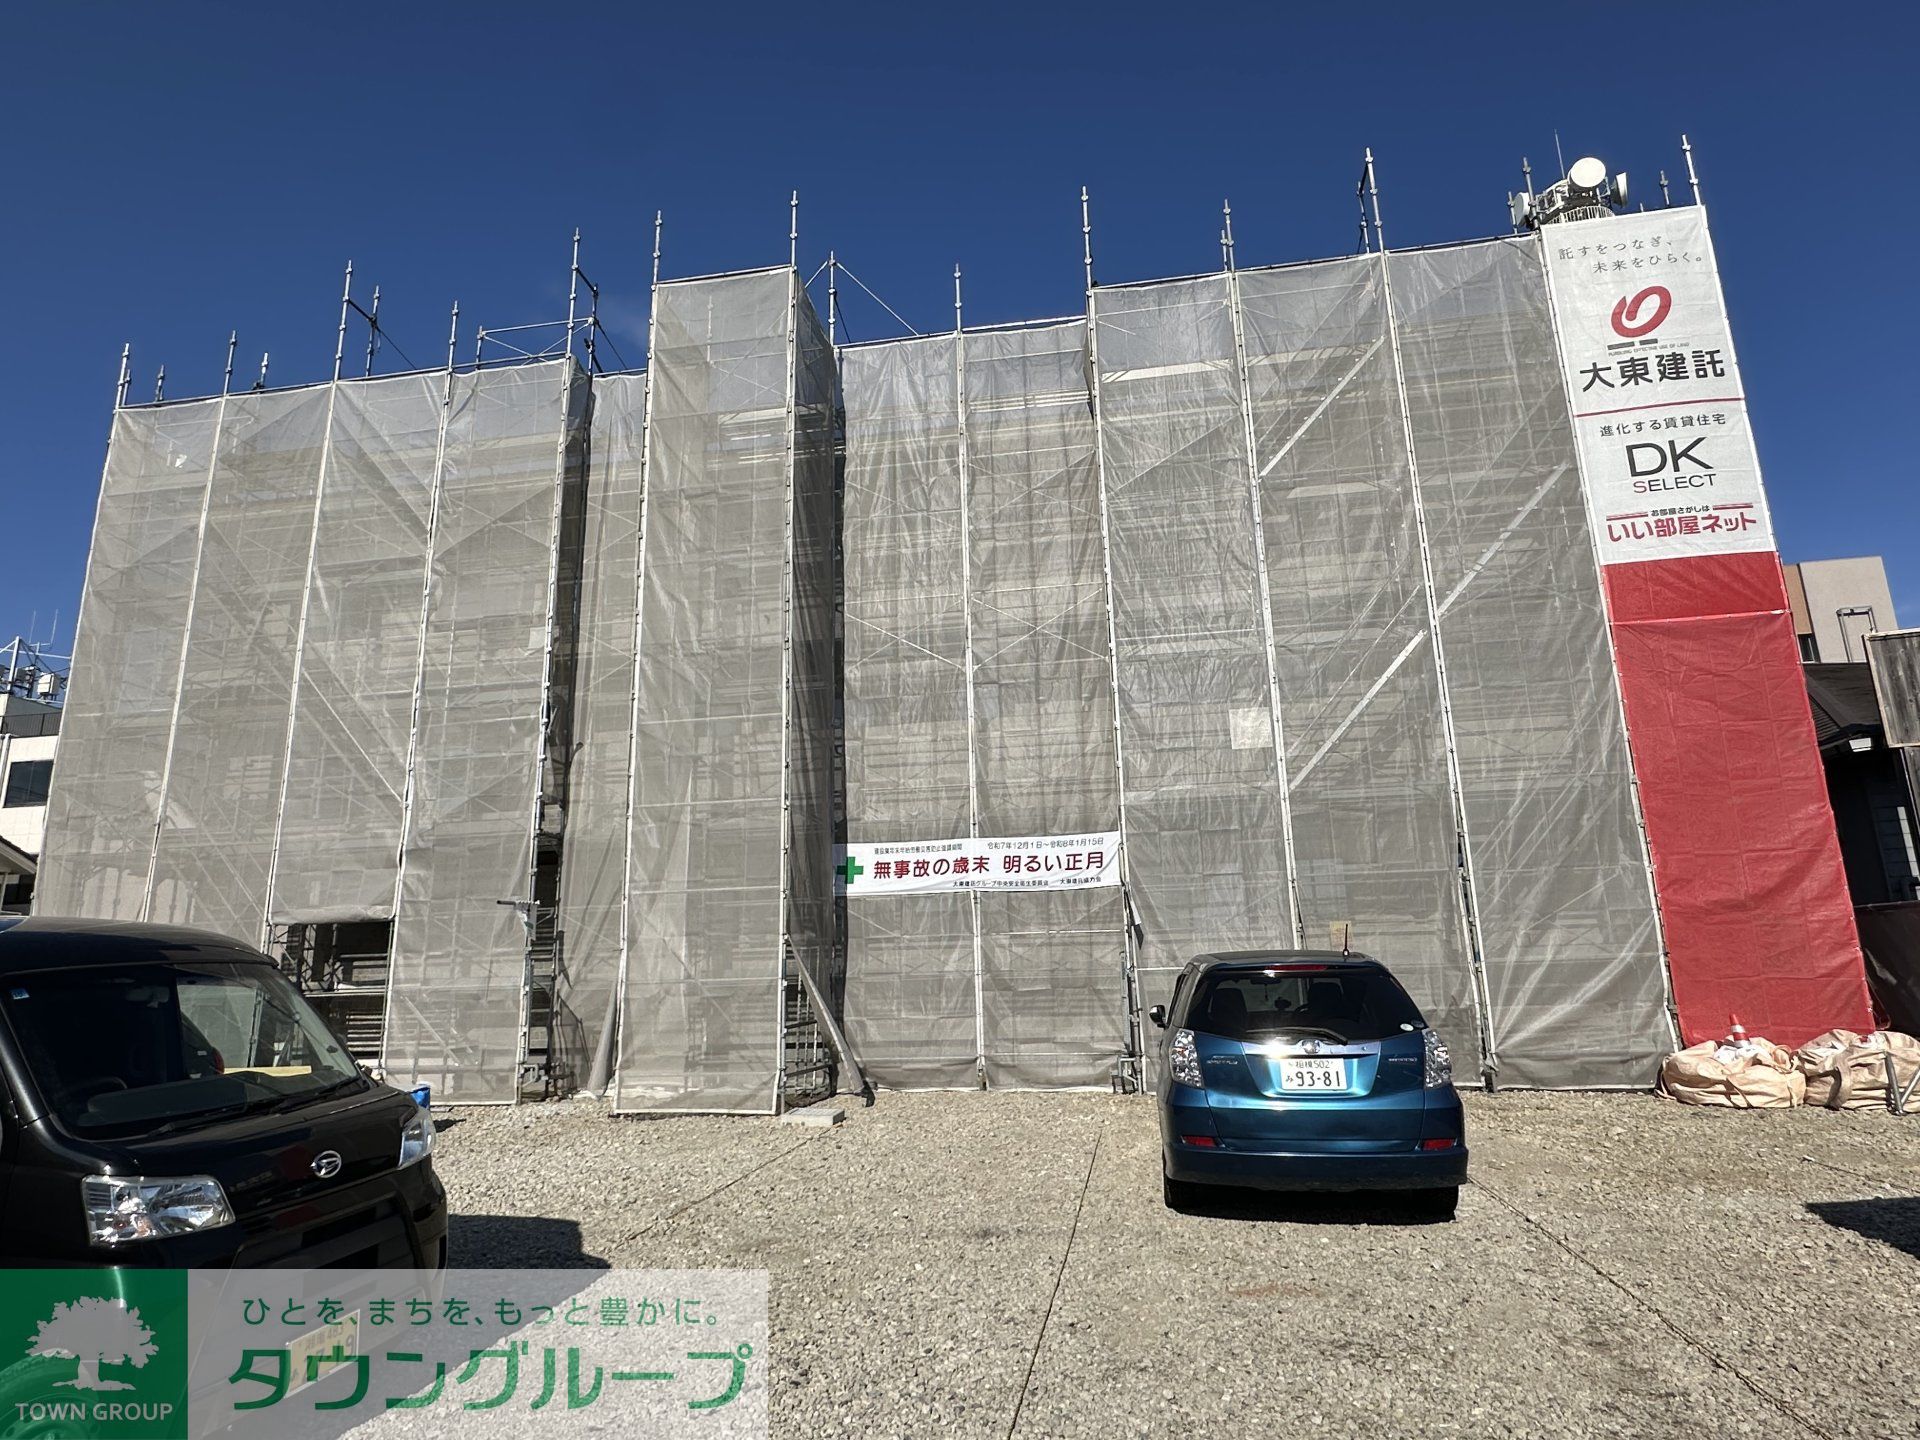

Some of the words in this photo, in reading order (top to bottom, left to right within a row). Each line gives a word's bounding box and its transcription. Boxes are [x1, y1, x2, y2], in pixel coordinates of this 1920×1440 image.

[1559, 236, 1673, 260] 託すをつなぎ、
[1593, 254, 1702, 274] 未来をひらく。
[1579, 349, 1726, 393] 大東建託
[1599, 413, 1727, 438] 進化する賃貸住宅
[1625, 436, 1714, 477] DK
[1633, 473, 1717, 494] SELECT
[1650, 504, 1711, 517] お部屋さがしは
[1607, 511, 1757, 543] いい部屋ネット
[873, 855, 991, 880] 無事故の歳末
[1002, 851, 1104, 874] 明るい正月
[1295, 1070, 1341, 1088] 93-81
